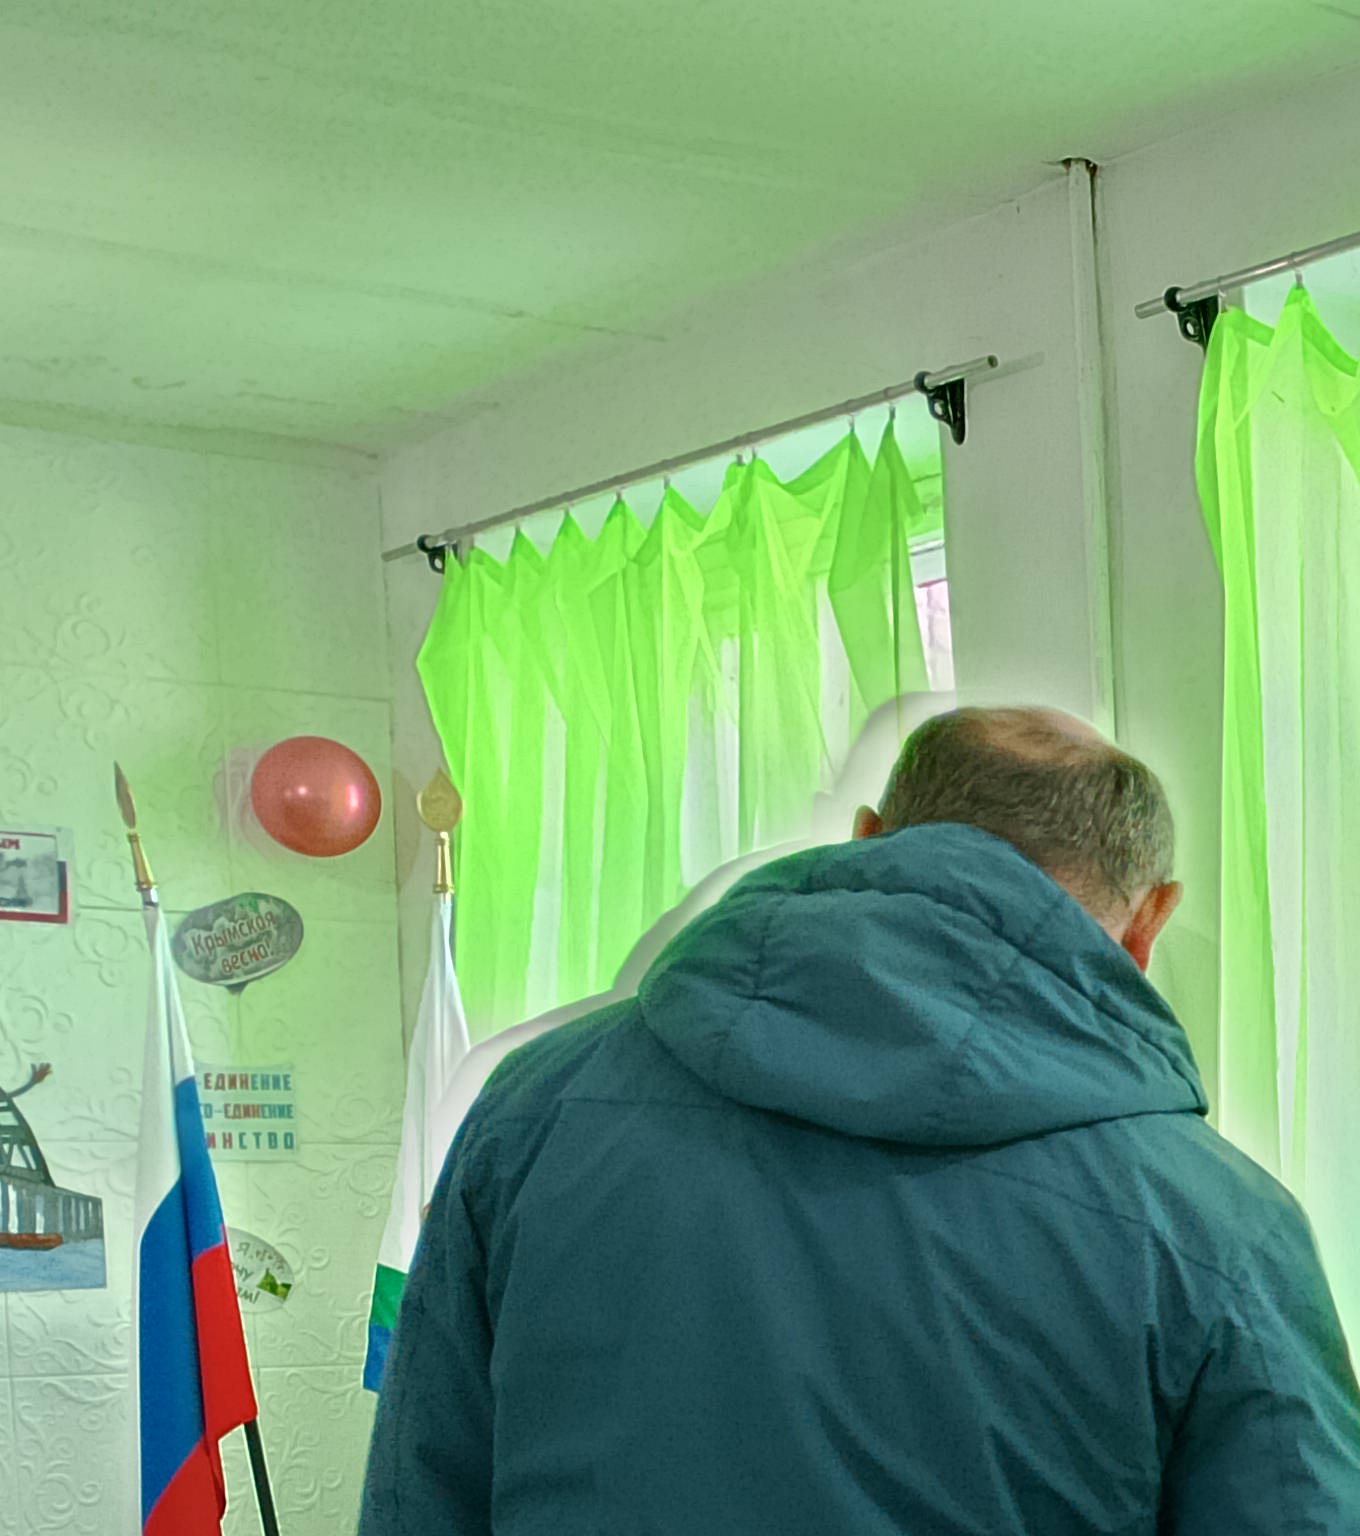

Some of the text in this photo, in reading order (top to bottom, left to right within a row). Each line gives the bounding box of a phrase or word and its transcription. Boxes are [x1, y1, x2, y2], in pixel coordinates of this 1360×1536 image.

[191, 910, 276, 955] Крымская
[221, 939, 275, 974] весна!
[201, 1103, 294, 1119] О-ЕДИНЕНИЕ
